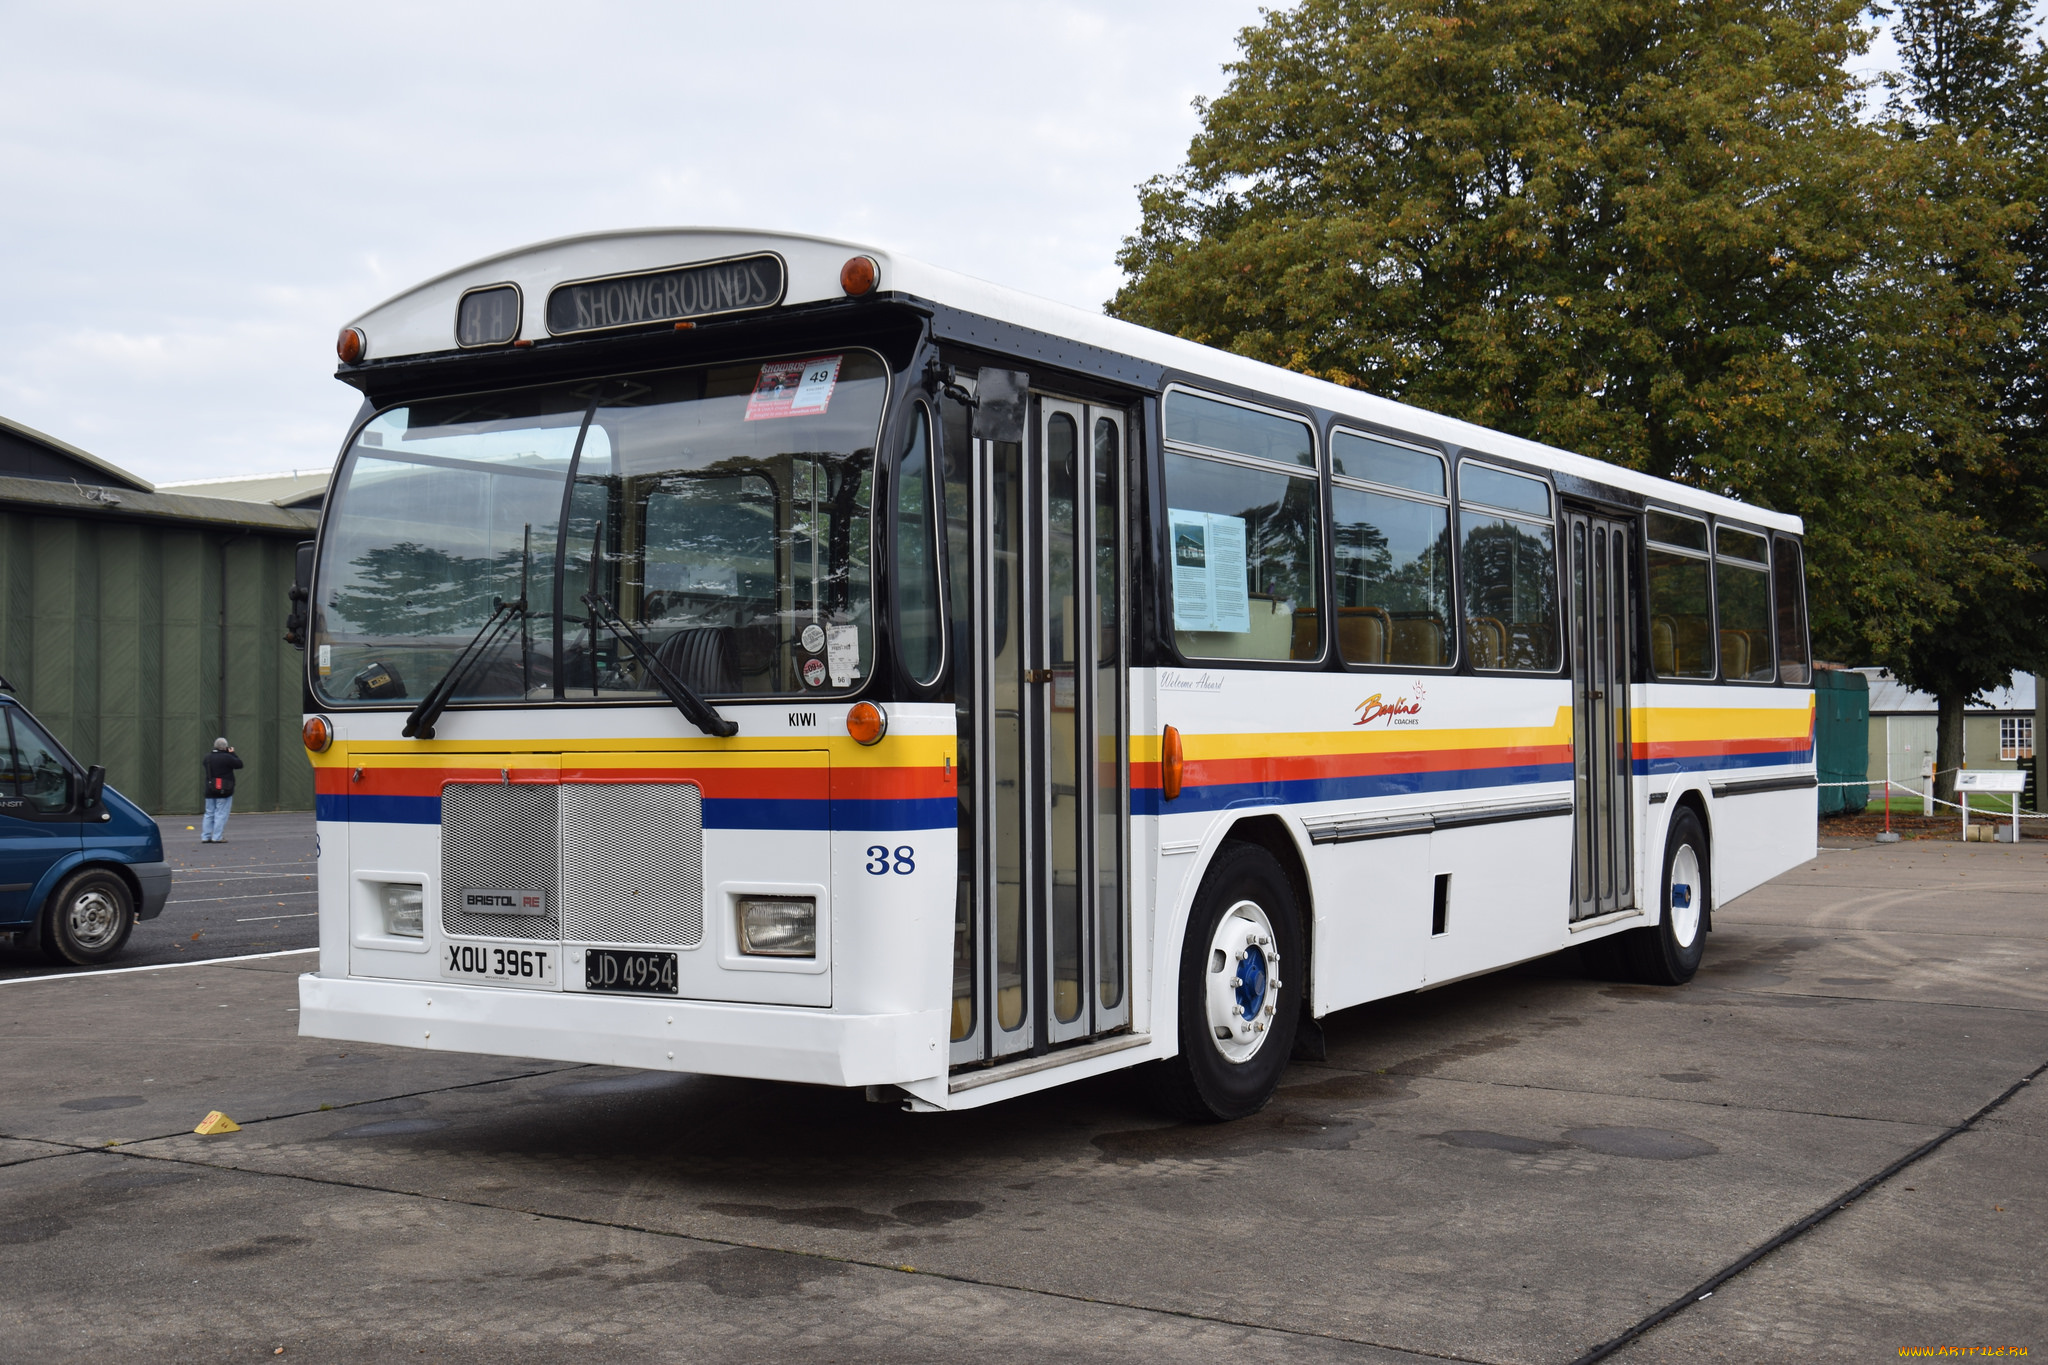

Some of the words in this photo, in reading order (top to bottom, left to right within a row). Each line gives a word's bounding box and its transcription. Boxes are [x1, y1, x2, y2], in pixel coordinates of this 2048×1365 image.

[576, 264, 767, 329] SHOWGROUNDS
[809, 370, 829, 383] 49
[1160, 671, 1193, 688] Welcome
[1196, 672, 1225, 689] Aboard
[788, 712, 816, 726] KIWI
[1353, 693, 1422, 727] Bayline
[866, 845, 915, 875] 38
[467, 894, 516, 907] BRISTOL
[523, 896, 540, 908] RE
[449, 945, 487, 974] XOU
[493, 949, 547, 978] 396T
[590, 954, 618, 985] JD
[623, 956, 673, 989] 4954
